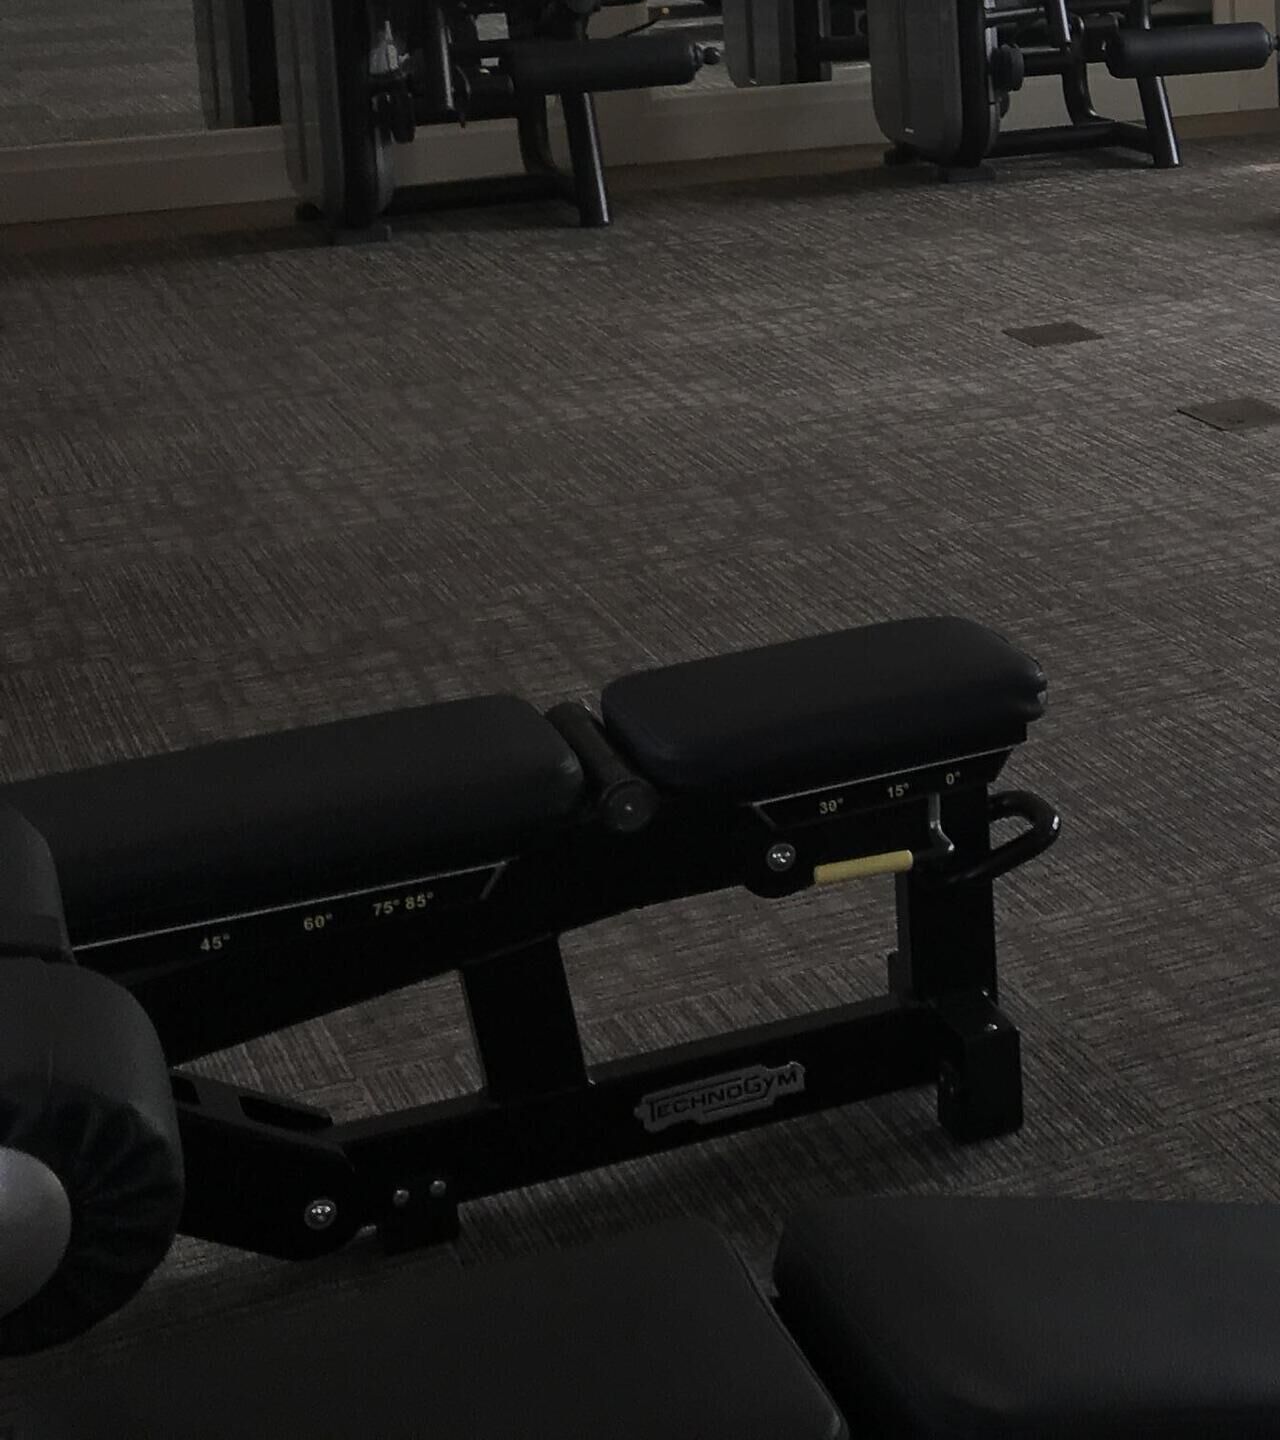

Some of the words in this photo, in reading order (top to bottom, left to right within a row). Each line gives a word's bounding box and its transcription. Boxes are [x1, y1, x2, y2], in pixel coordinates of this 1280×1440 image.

[818, 797, 844, 815] 30°
[887, 782, 910, 799] 15°
[945, 771, 961, 786] 0°
[199, 933, 231, 952] 45°
[302, 913, 334, 932] 60°
[372, 898, 401, 917] 75°
[404, 891, 434, 911] 85°
[645, 1070, 797, 1123] TECHNOGYM
